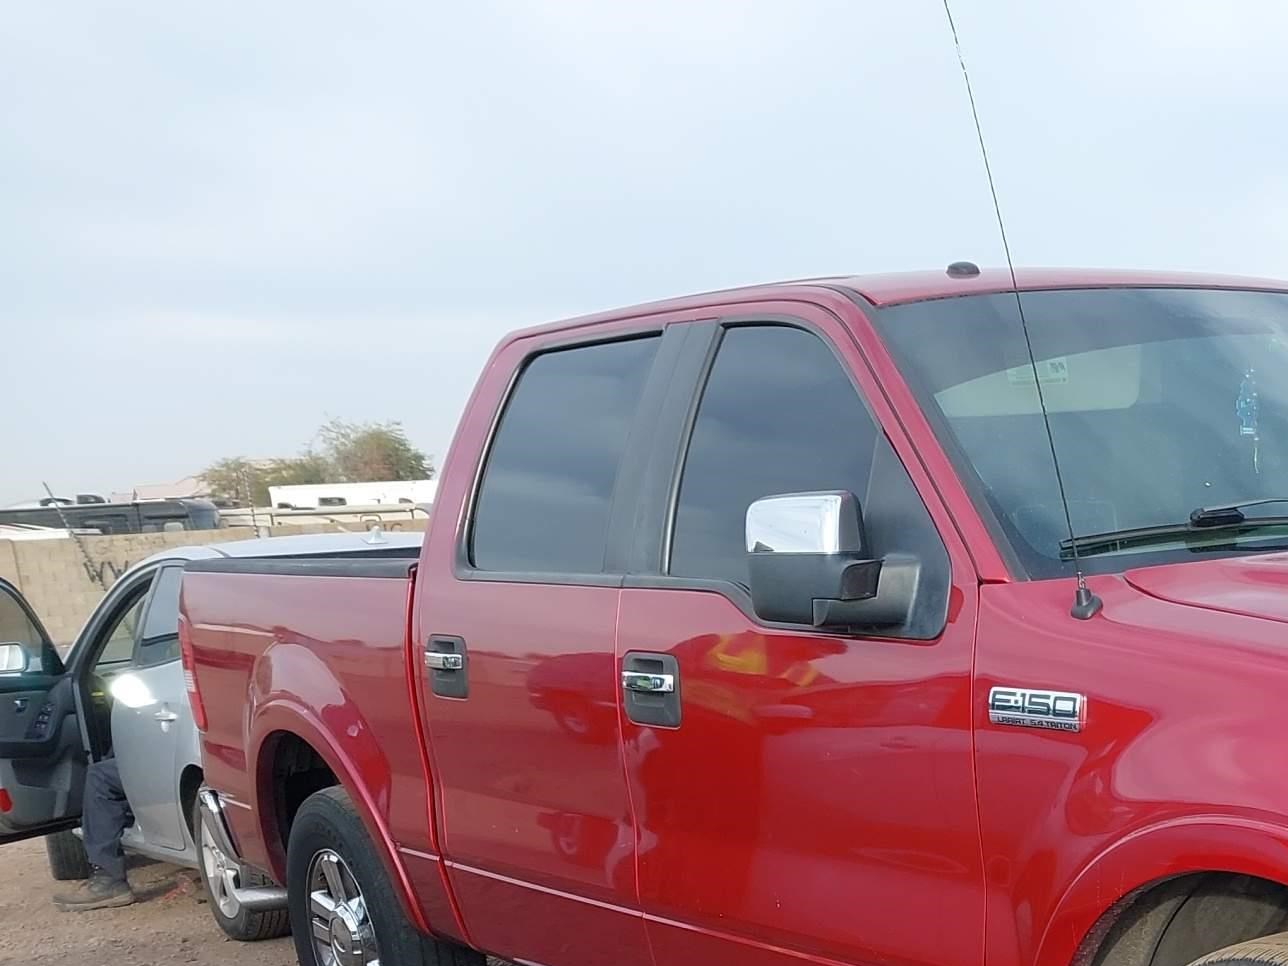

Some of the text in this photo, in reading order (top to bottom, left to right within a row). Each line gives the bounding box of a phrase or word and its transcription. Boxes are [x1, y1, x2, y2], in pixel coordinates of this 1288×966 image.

[991, 690, 1078, 718] F-150
[997, 716, 1027, 726] LARIAT
[1045, 721, 1077, 731] TRITON
